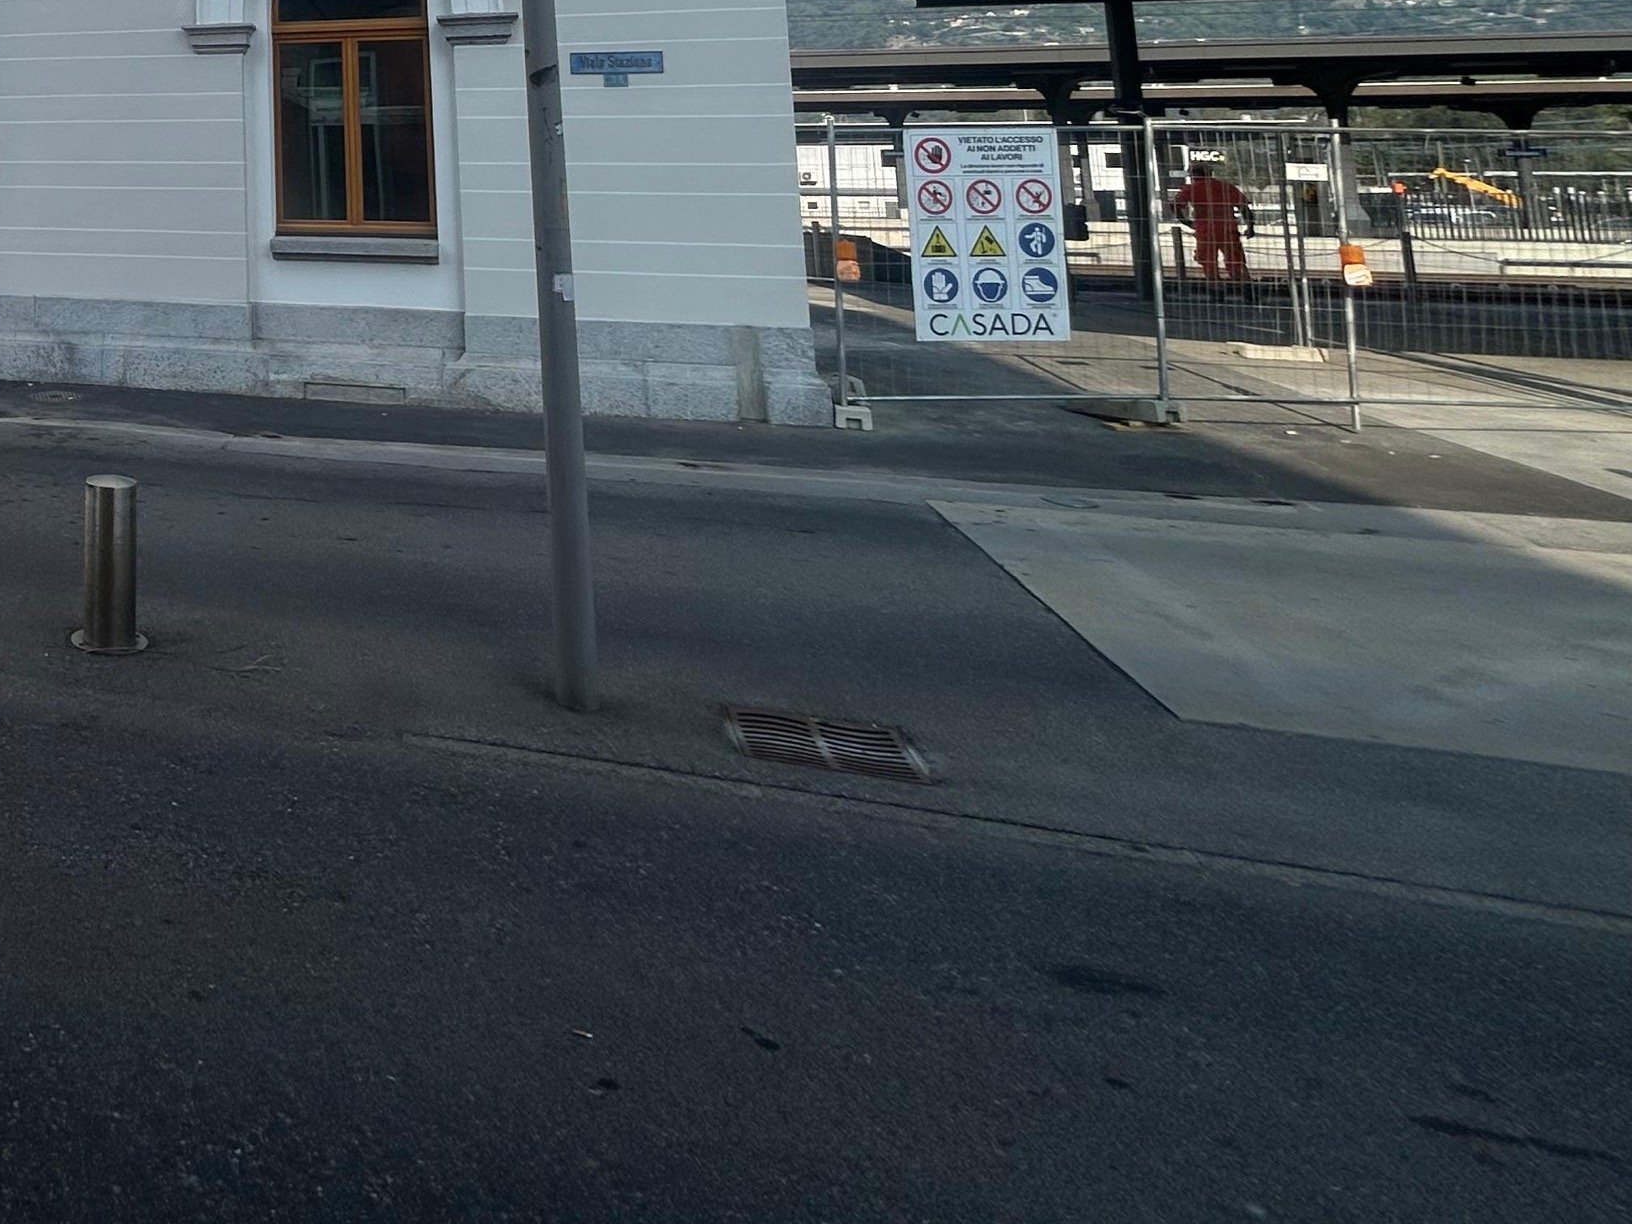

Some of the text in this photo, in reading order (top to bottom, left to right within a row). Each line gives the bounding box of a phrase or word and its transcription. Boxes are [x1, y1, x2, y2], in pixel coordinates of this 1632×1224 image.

[995, 136, 1044, 144] L'ACCESSO
[977, 145, 996, 153] NON
[997, 144, 1036, 153] ADDETTI
[981, 153, 1023, 161] AI LAVORI
[929, 313, 1055, 336] CASADA
